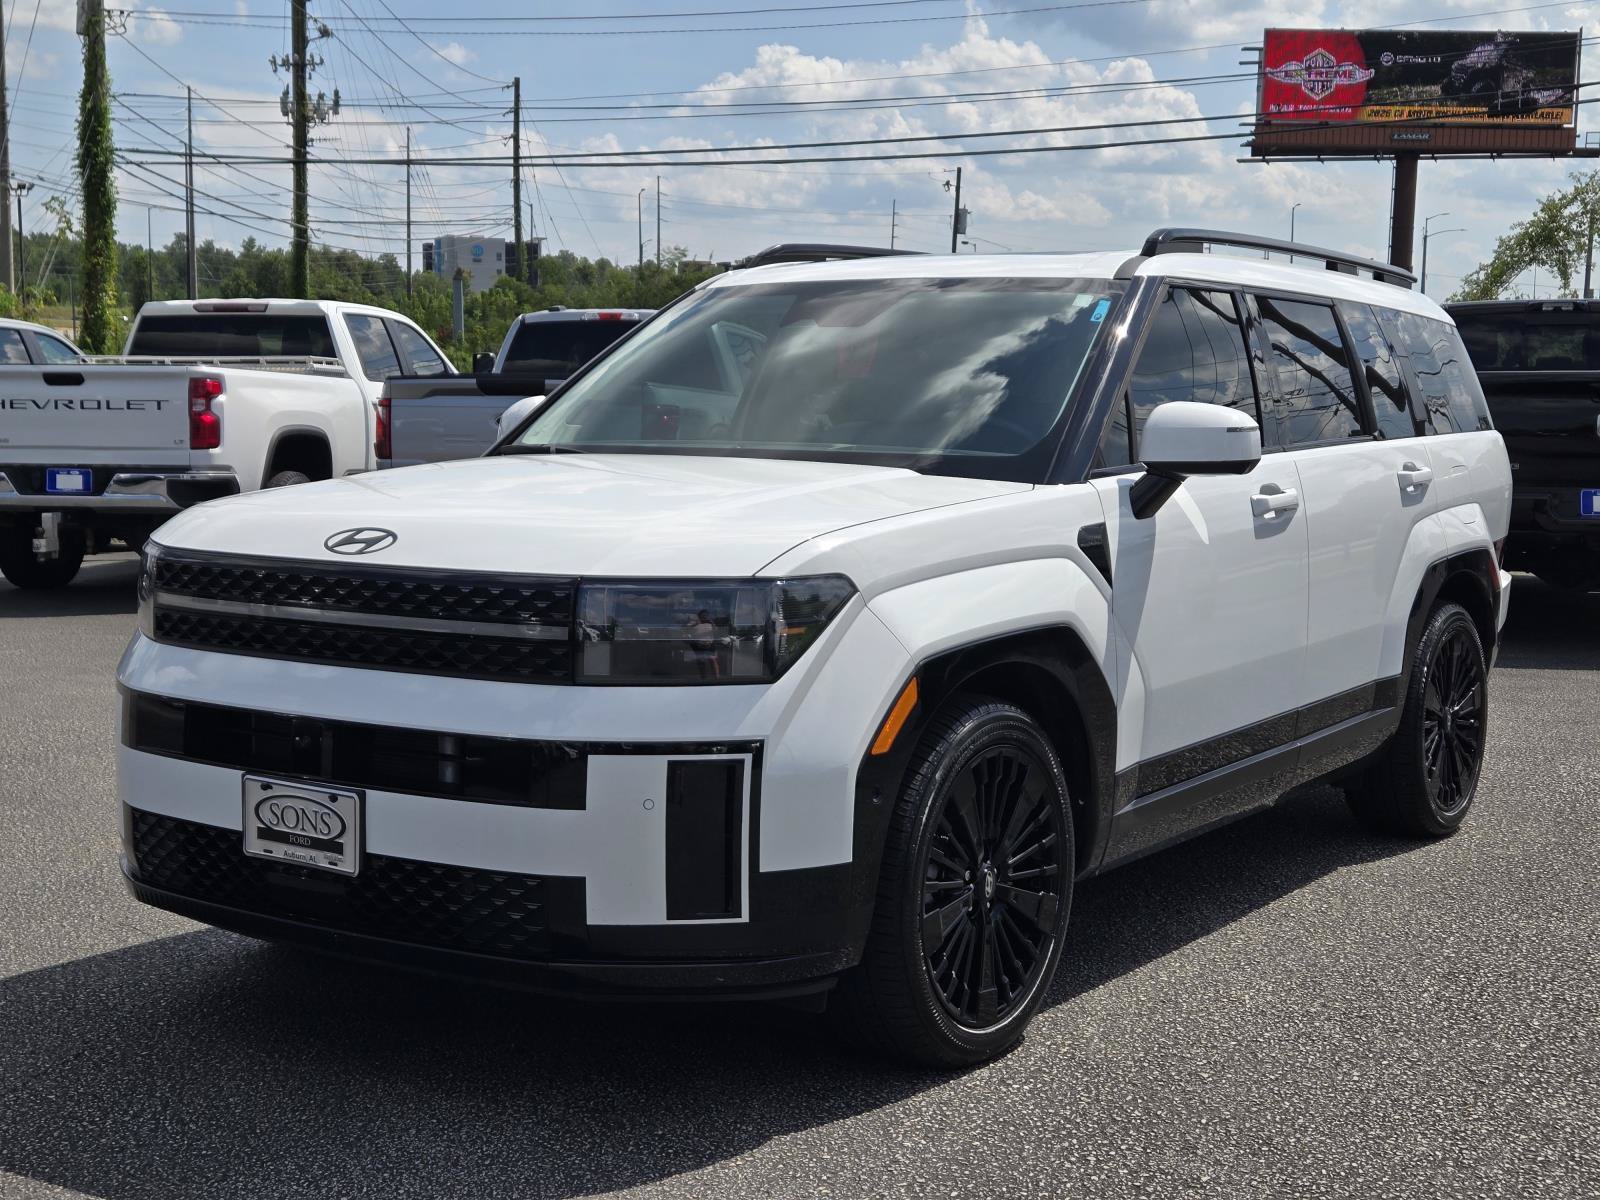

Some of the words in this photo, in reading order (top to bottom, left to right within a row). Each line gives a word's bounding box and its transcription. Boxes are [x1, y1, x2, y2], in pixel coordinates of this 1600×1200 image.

[1284, 69, 1357, 79] EXTREME
[268, 802, 331, 836] SONS
[289, 834, 311, 846] FORD
[283, 849, 307, 862] Auburn,
